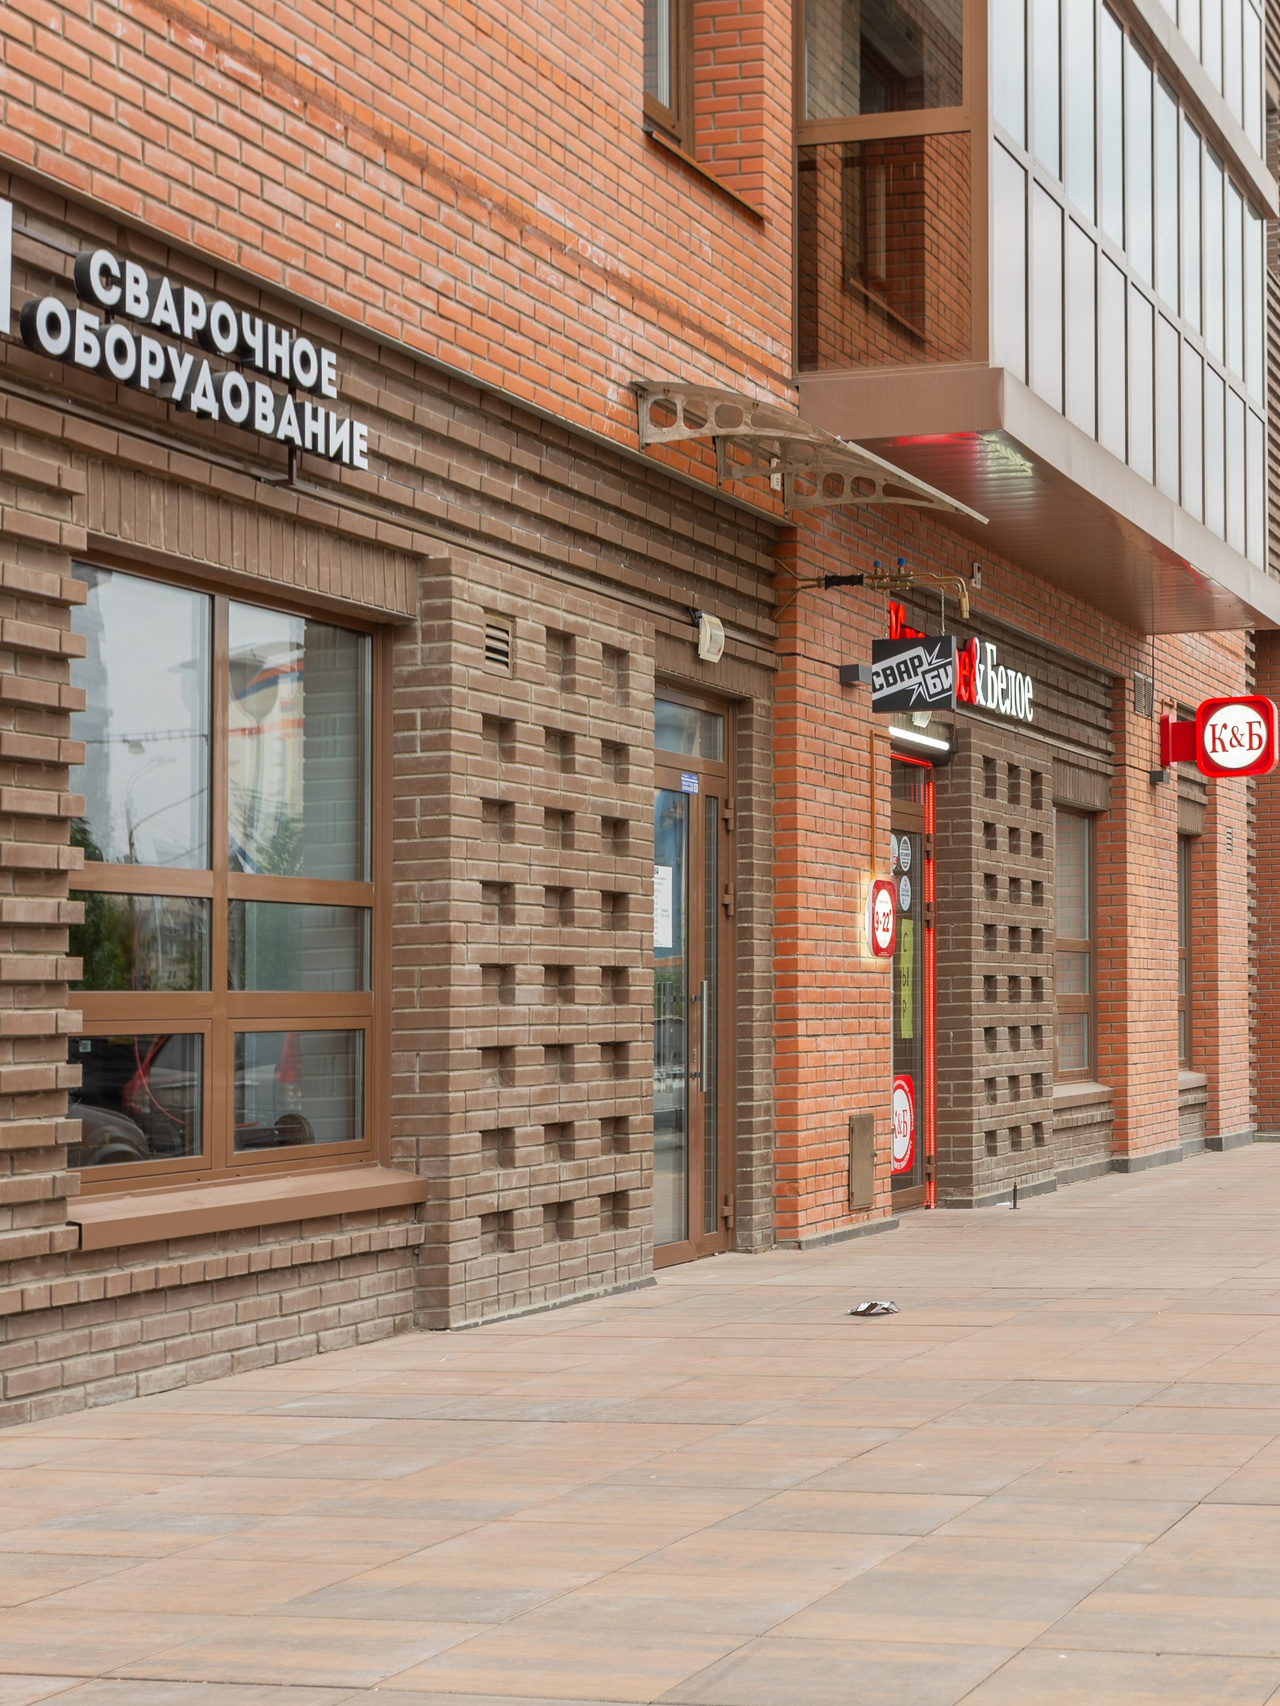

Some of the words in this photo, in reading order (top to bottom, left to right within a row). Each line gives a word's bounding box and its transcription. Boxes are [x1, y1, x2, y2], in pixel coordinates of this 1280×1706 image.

[88, 248, 338, 400] СВАРОЧНОЕ
[35, 296, 369, 471] ОБОРУДОВАНИЕ
[872, 653, 925, 694] СВАР
[1208, 720, 1264, 754] К&Б
